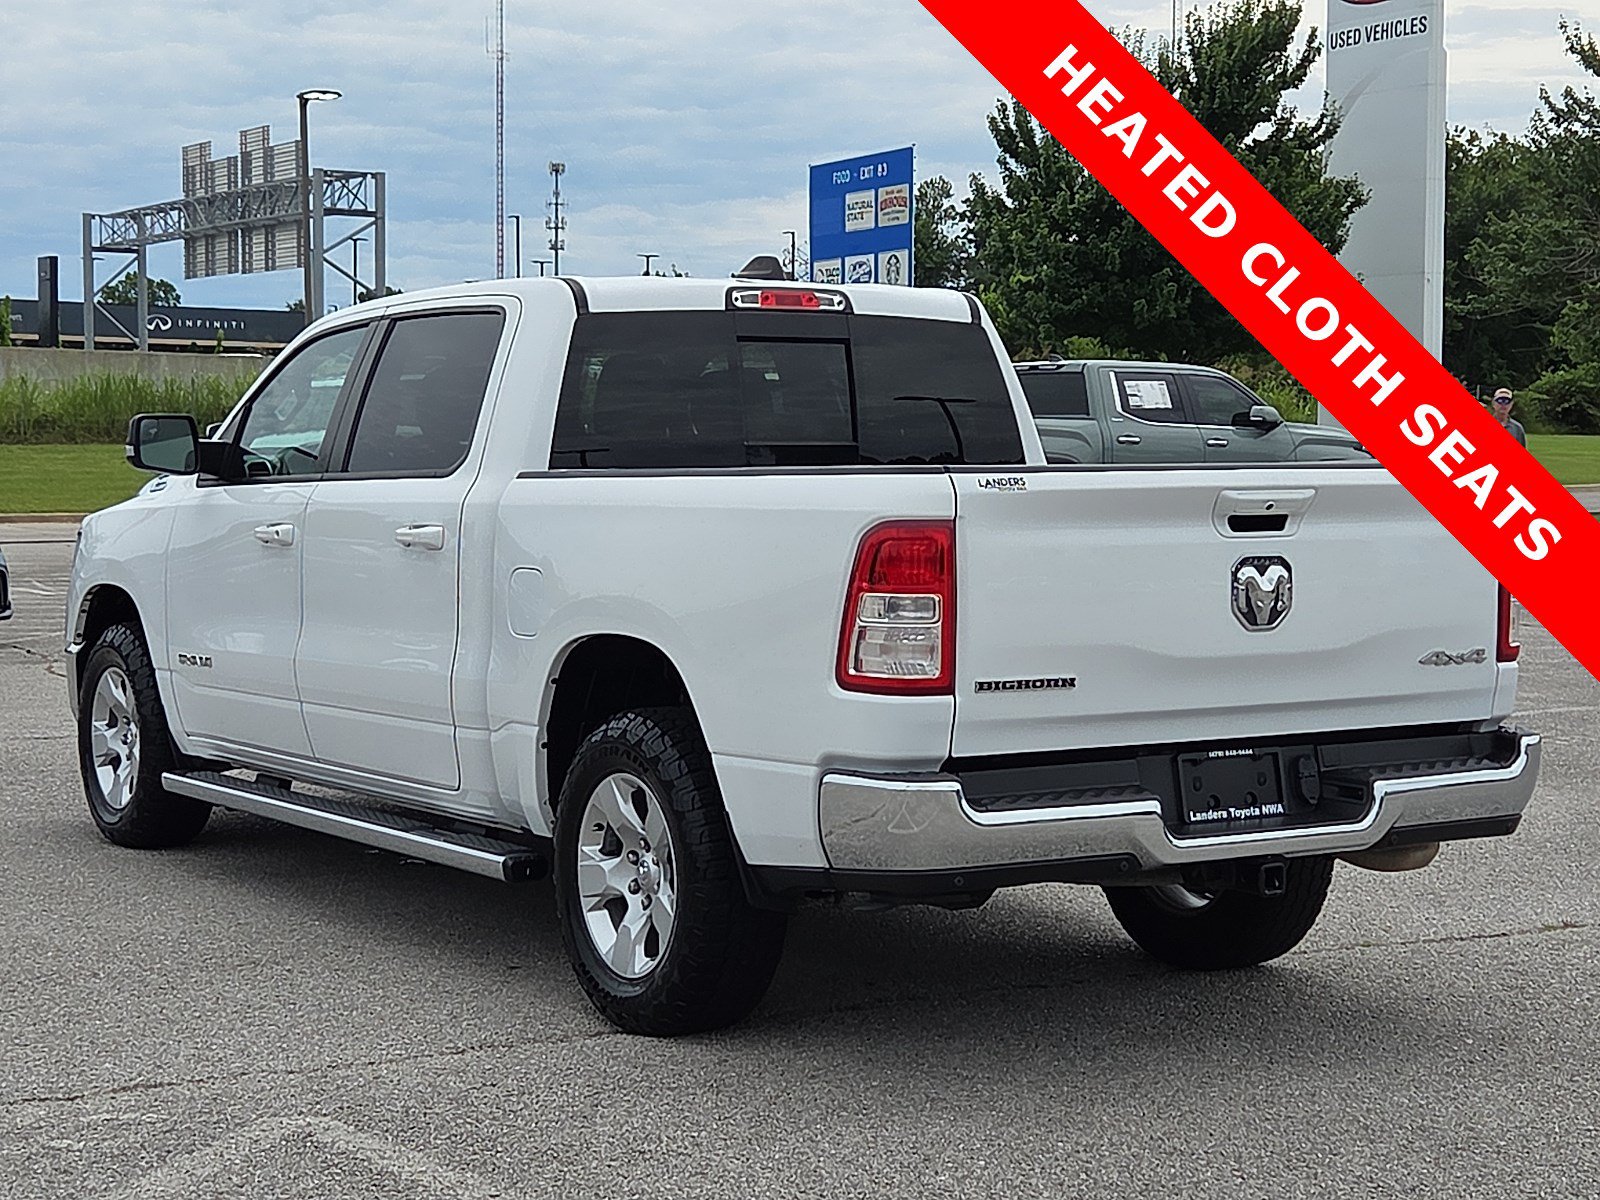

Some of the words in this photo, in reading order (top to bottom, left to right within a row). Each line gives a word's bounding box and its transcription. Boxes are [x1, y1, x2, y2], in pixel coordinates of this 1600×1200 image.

[1330, 28, 1361, 50] USED
[1365, 15, 1428, 43] VEHICLES
[833, 169, 850, 185] FOOD
[847, 211, 865, 223] STATE
[178, 319, 245, 330] INFINITI
[978, 477, 1026, 489] LANDERS
[975, 677, 1076, 693] BIGHORN
[1189, 808, 1228, 822] Landers
[1228, 805, 1260, 819] Toyota
[1261, 803, 1284, 815] NWA
